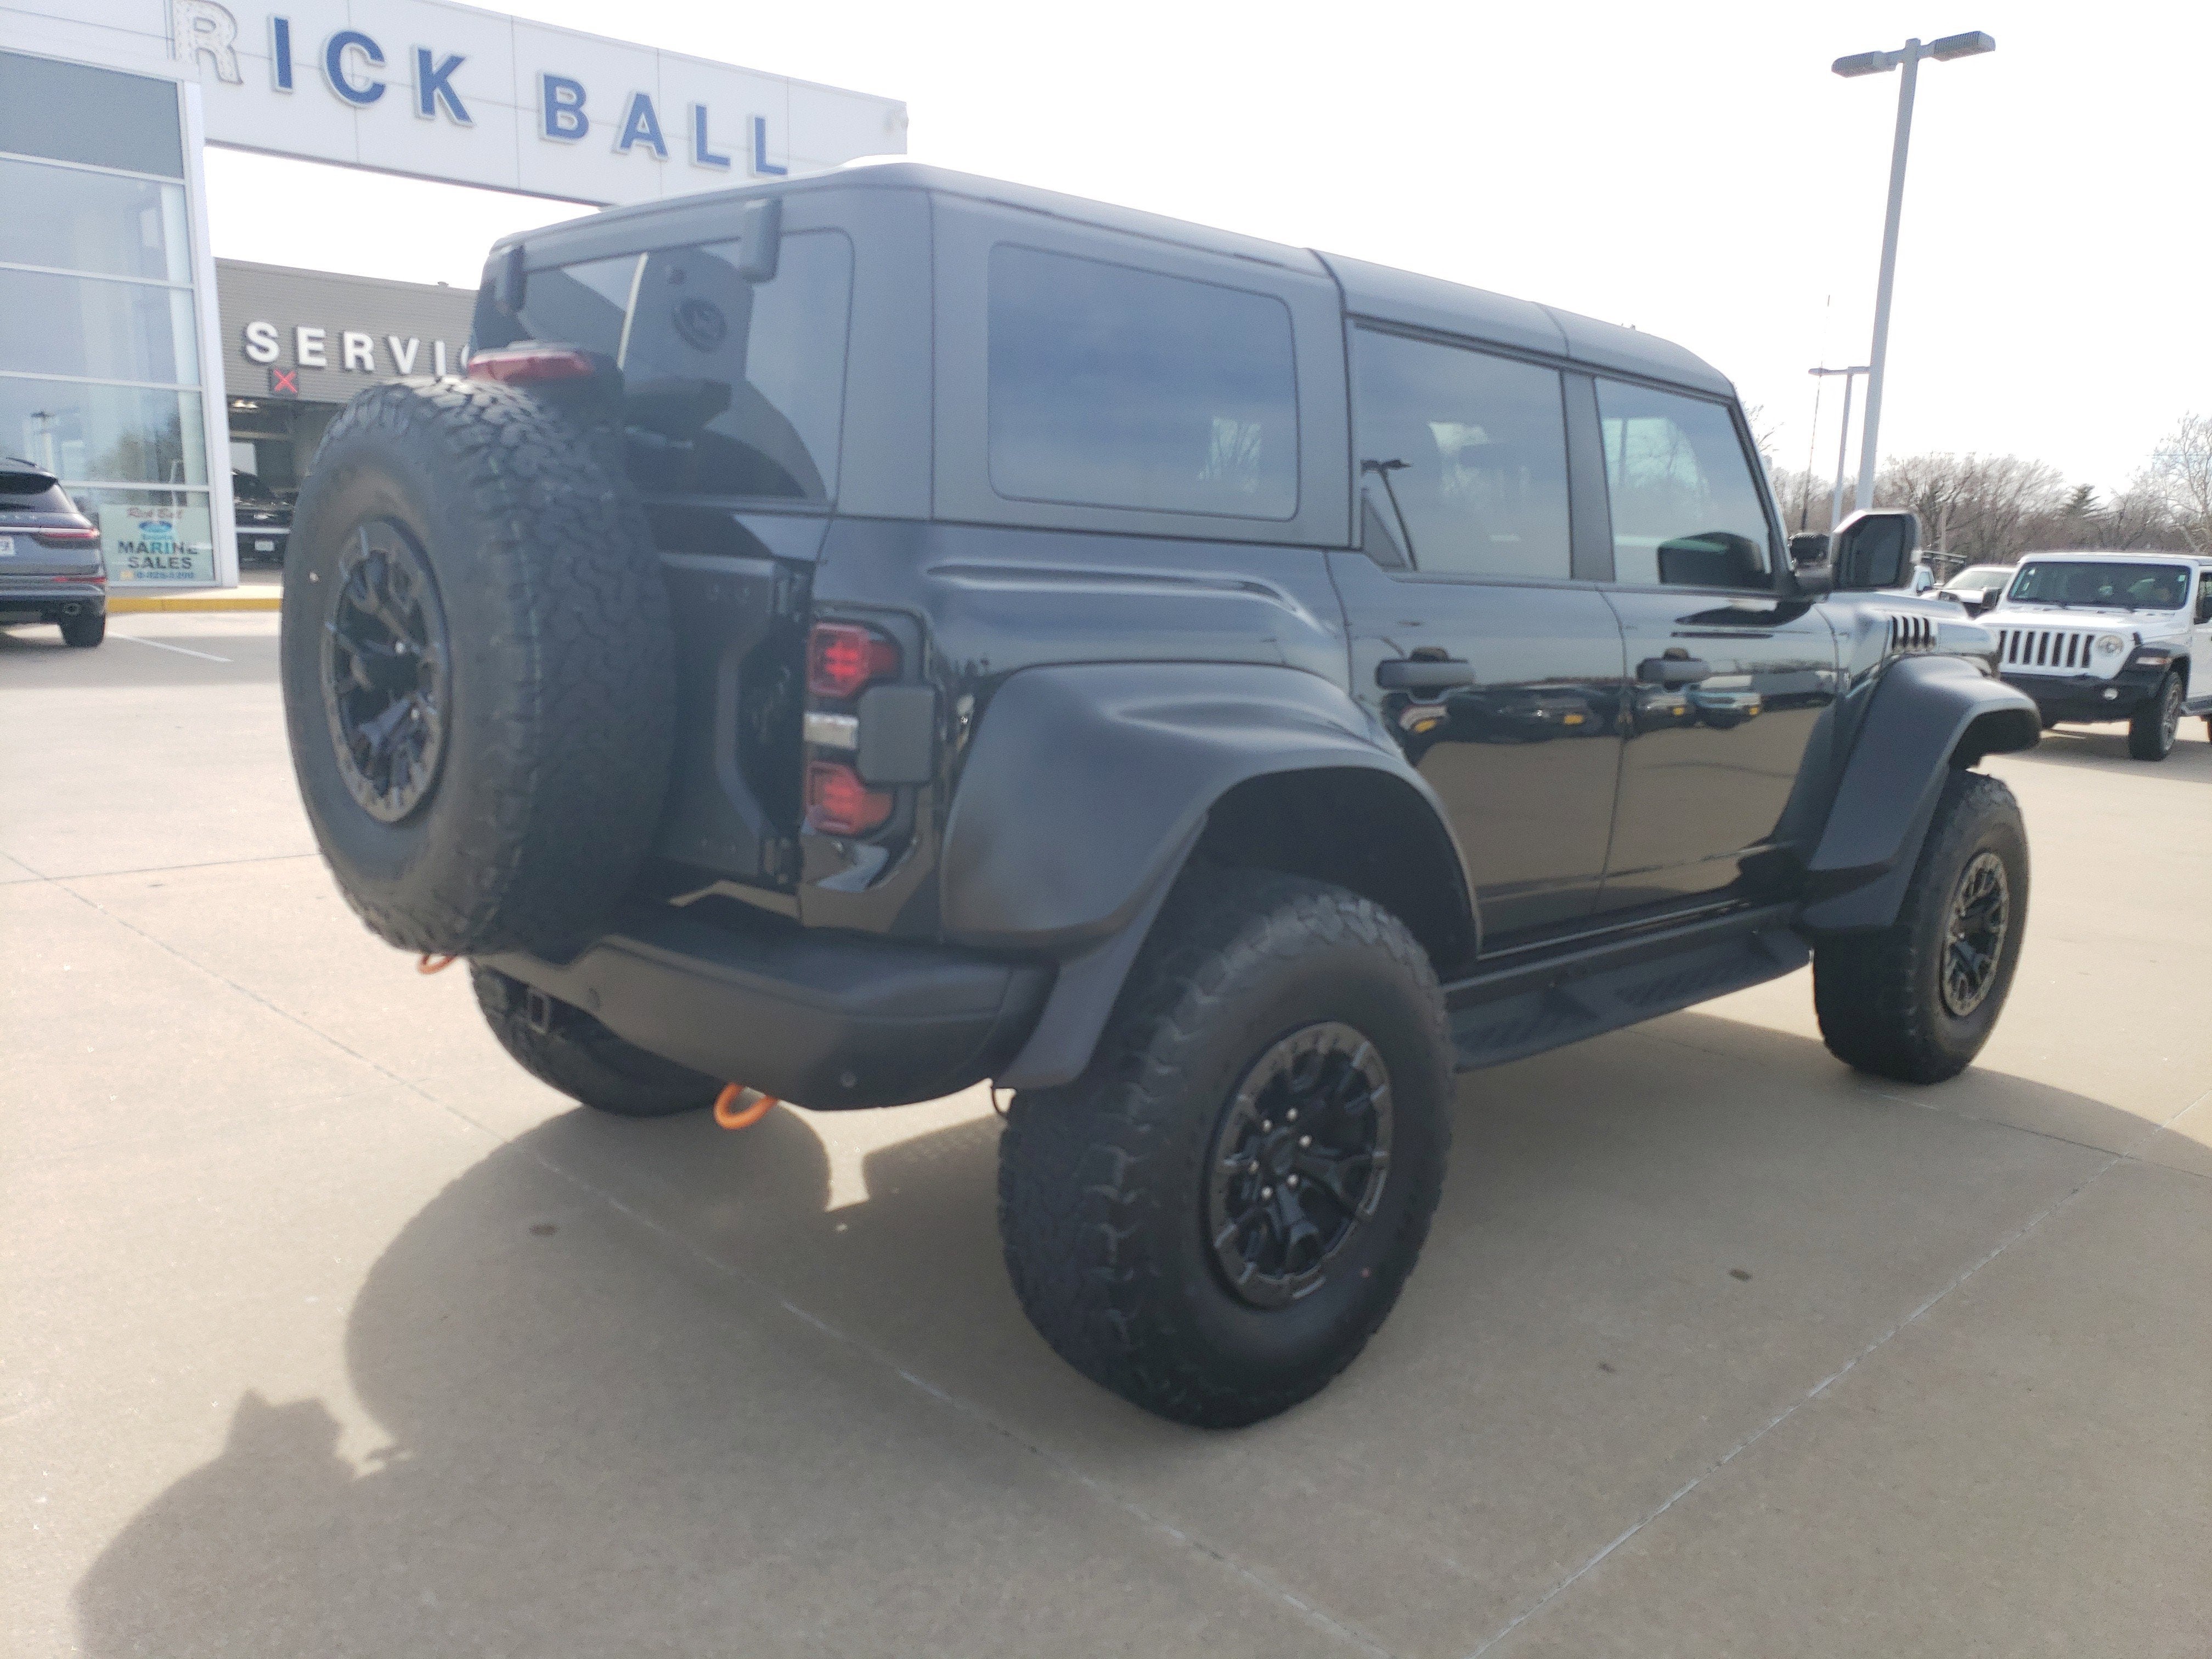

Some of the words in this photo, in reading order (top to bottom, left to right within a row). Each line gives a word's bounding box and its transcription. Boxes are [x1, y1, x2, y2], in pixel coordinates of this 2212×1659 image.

[165, 0, 475, 127] RICK
[537, 70, 788, 177] BALL
[245, 321, 470, 375] SERVI
[127, 556, 193, 569] SALES
